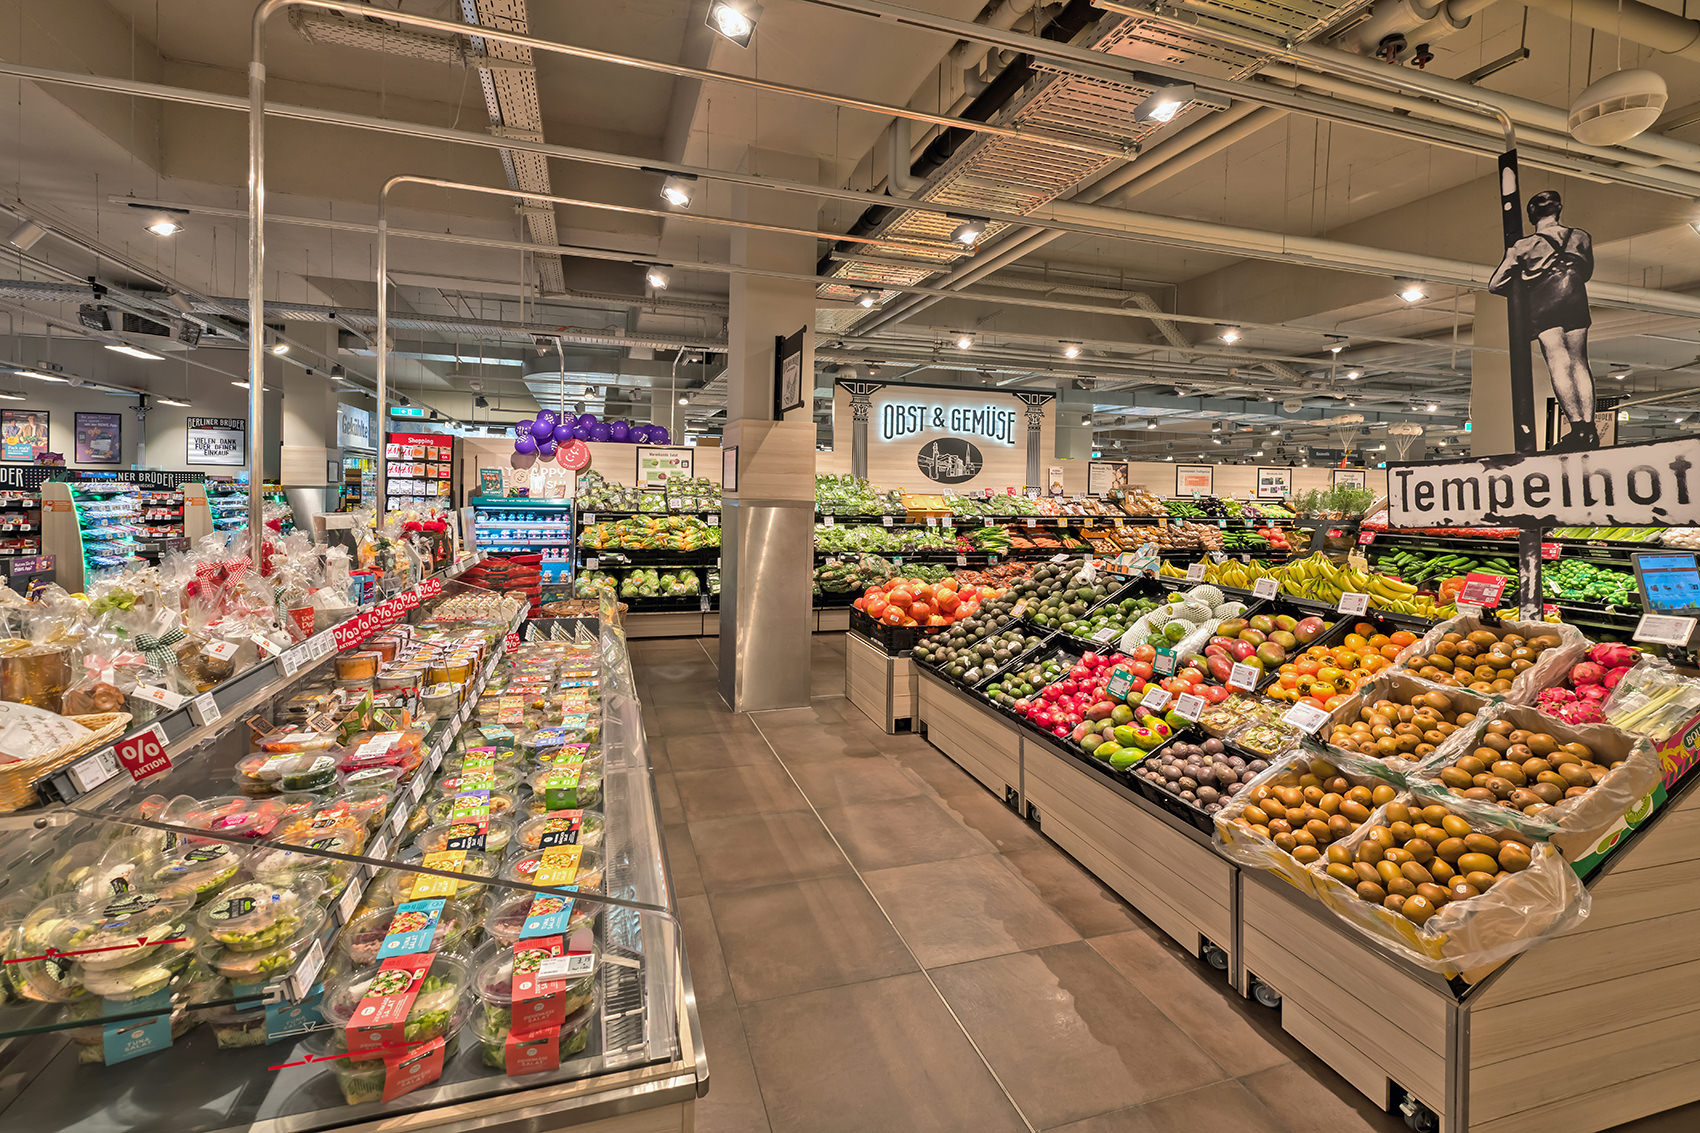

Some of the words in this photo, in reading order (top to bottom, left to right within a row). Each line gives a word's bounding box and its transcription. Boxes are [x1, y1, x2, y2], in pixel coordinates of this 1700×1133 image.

[188, 417, 219, 429] BERLINER
[884, 404, 927, 440] OBST
[933, 407, 945, 428] &
[951, 406, 1016, 445] GEMÜSE
[138, 472, 174, 488] BRÜDER
[334, 628, 354, 642] %
[339, 639, 358, 650] AKTION
[122, 739, 160, 764] %
[134, 756, 166, 778] AKTION
[124, 1040, 152, 1052] SALAT
[126, 1037, 150, 1046] TUNA
